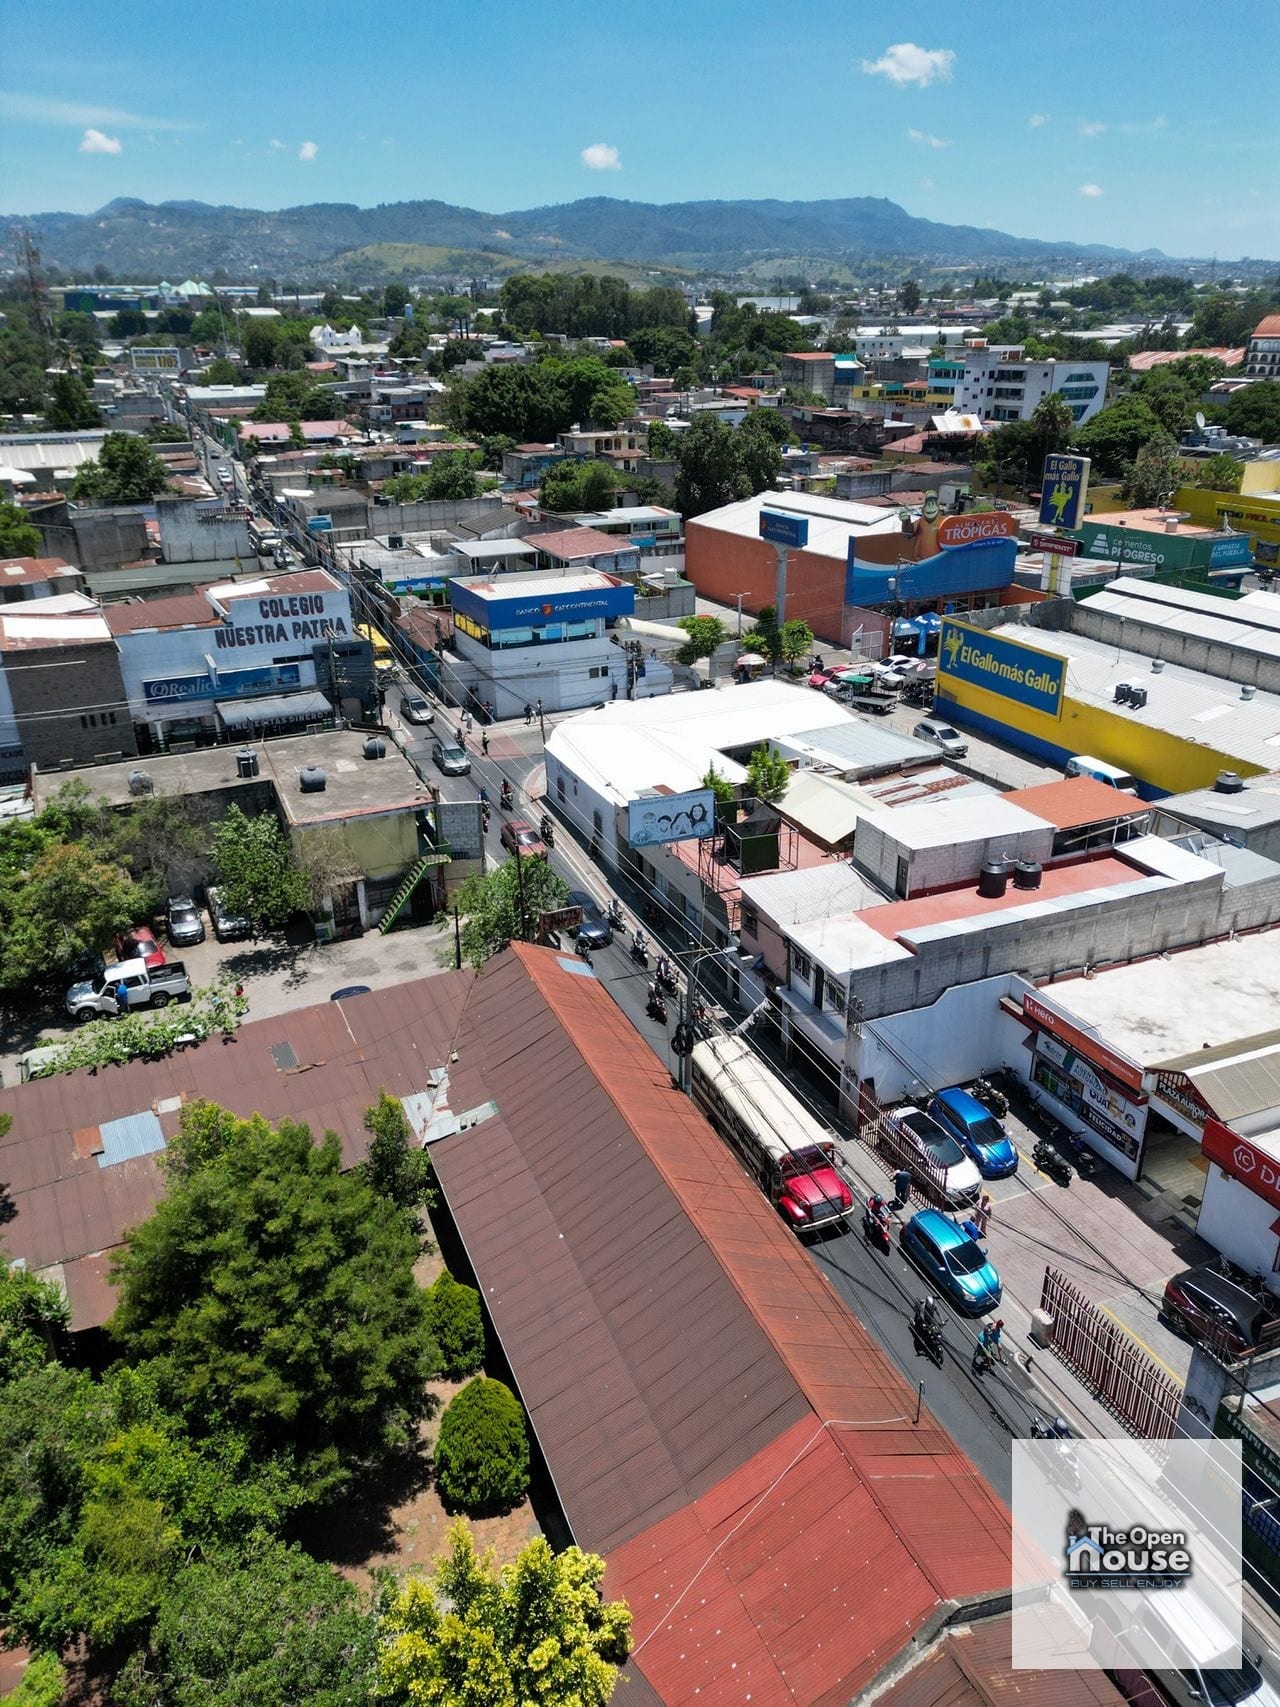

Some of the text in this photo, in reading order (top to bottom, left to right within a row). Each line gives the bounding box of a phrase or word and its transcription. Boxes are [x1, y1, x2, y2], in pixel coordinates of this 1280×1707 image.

[1050, 460, 1077, 471] El Gallo
[1061, 472, 1080, 481] Gallo
[944, 523, 1008, 540] TROPIGAS
[259, 595, 324, 619] COLEGIO
[214, 617, 348, 649] NUESTRA PATRIA
[961, 646, 1057, 695] El Gallo más Gallo
[1159, 1083, 1180, 1102] PLAZA
